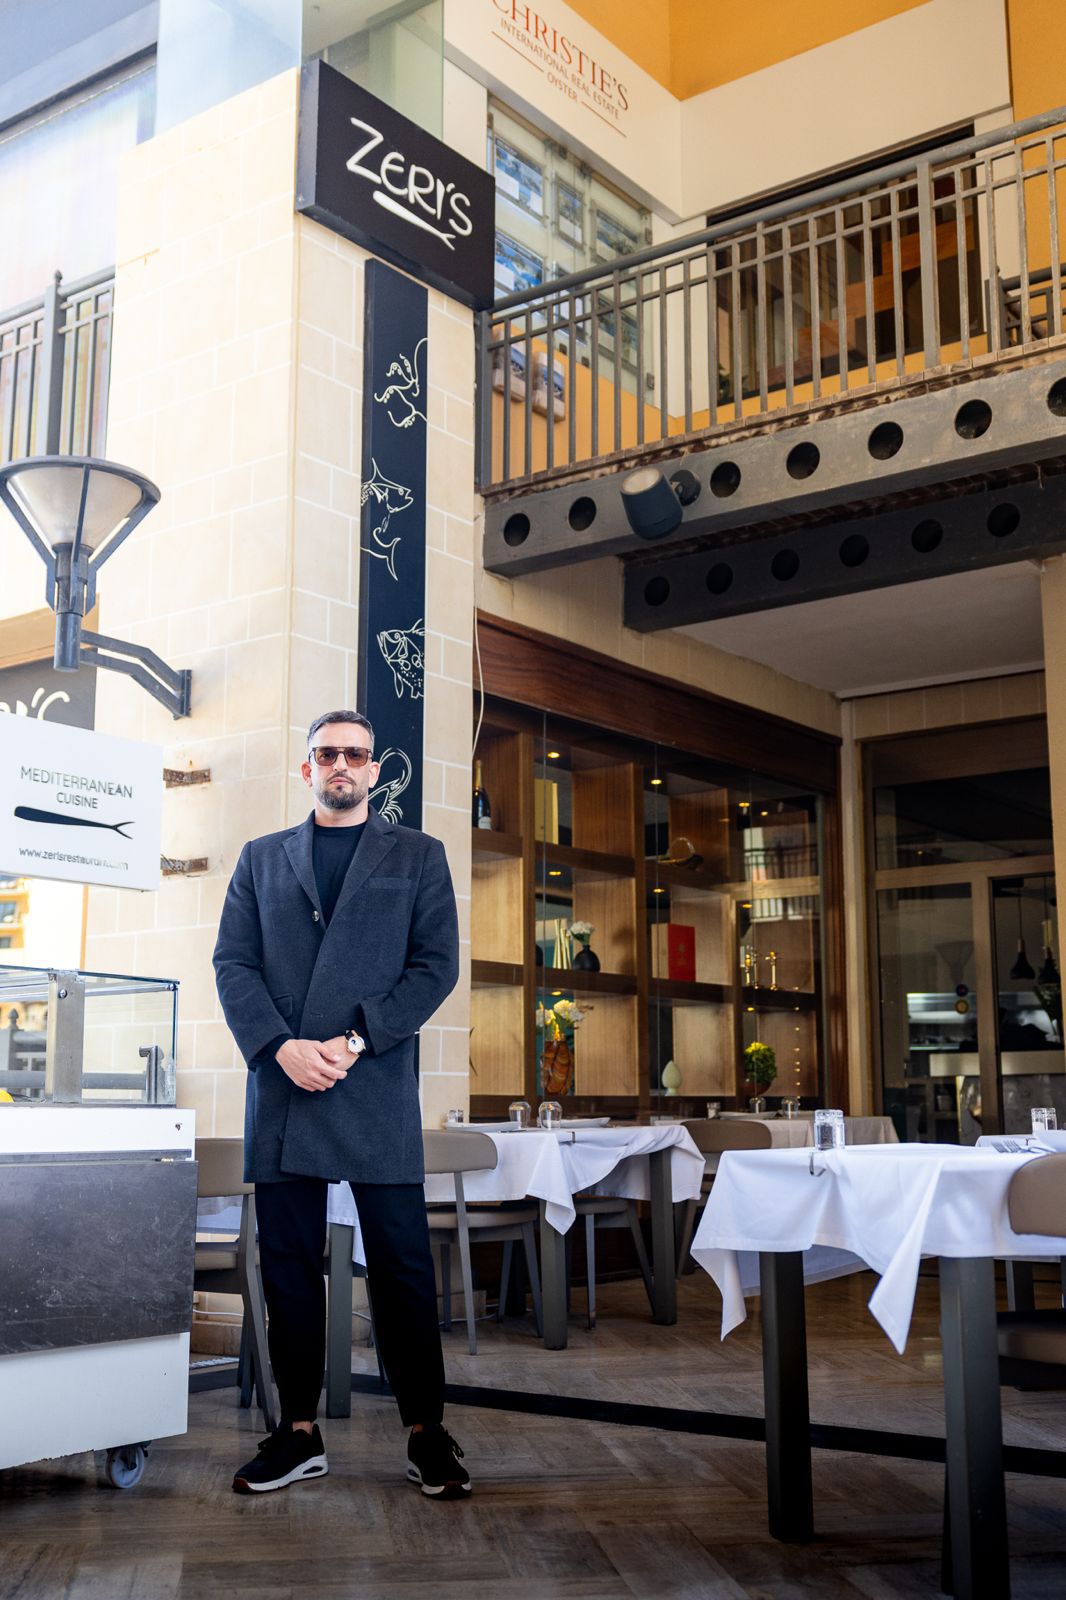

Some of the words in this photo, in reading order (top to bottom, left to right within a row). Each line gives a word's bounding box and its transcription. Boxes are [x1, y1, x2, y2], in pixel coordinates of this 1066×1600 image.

[500, 17, 569, 81] INTERNATIONAL
[571, 73, 591, 98] REAL
[592, 91, 620, 120] ESTATE
[546, 71, 578, 103] OYSTER
[346, 117, 473, 236] ZERI'S
[20, 765, 133, 799] MEDITERRANEAN
[56, 791, 99, 809] CUISINE
